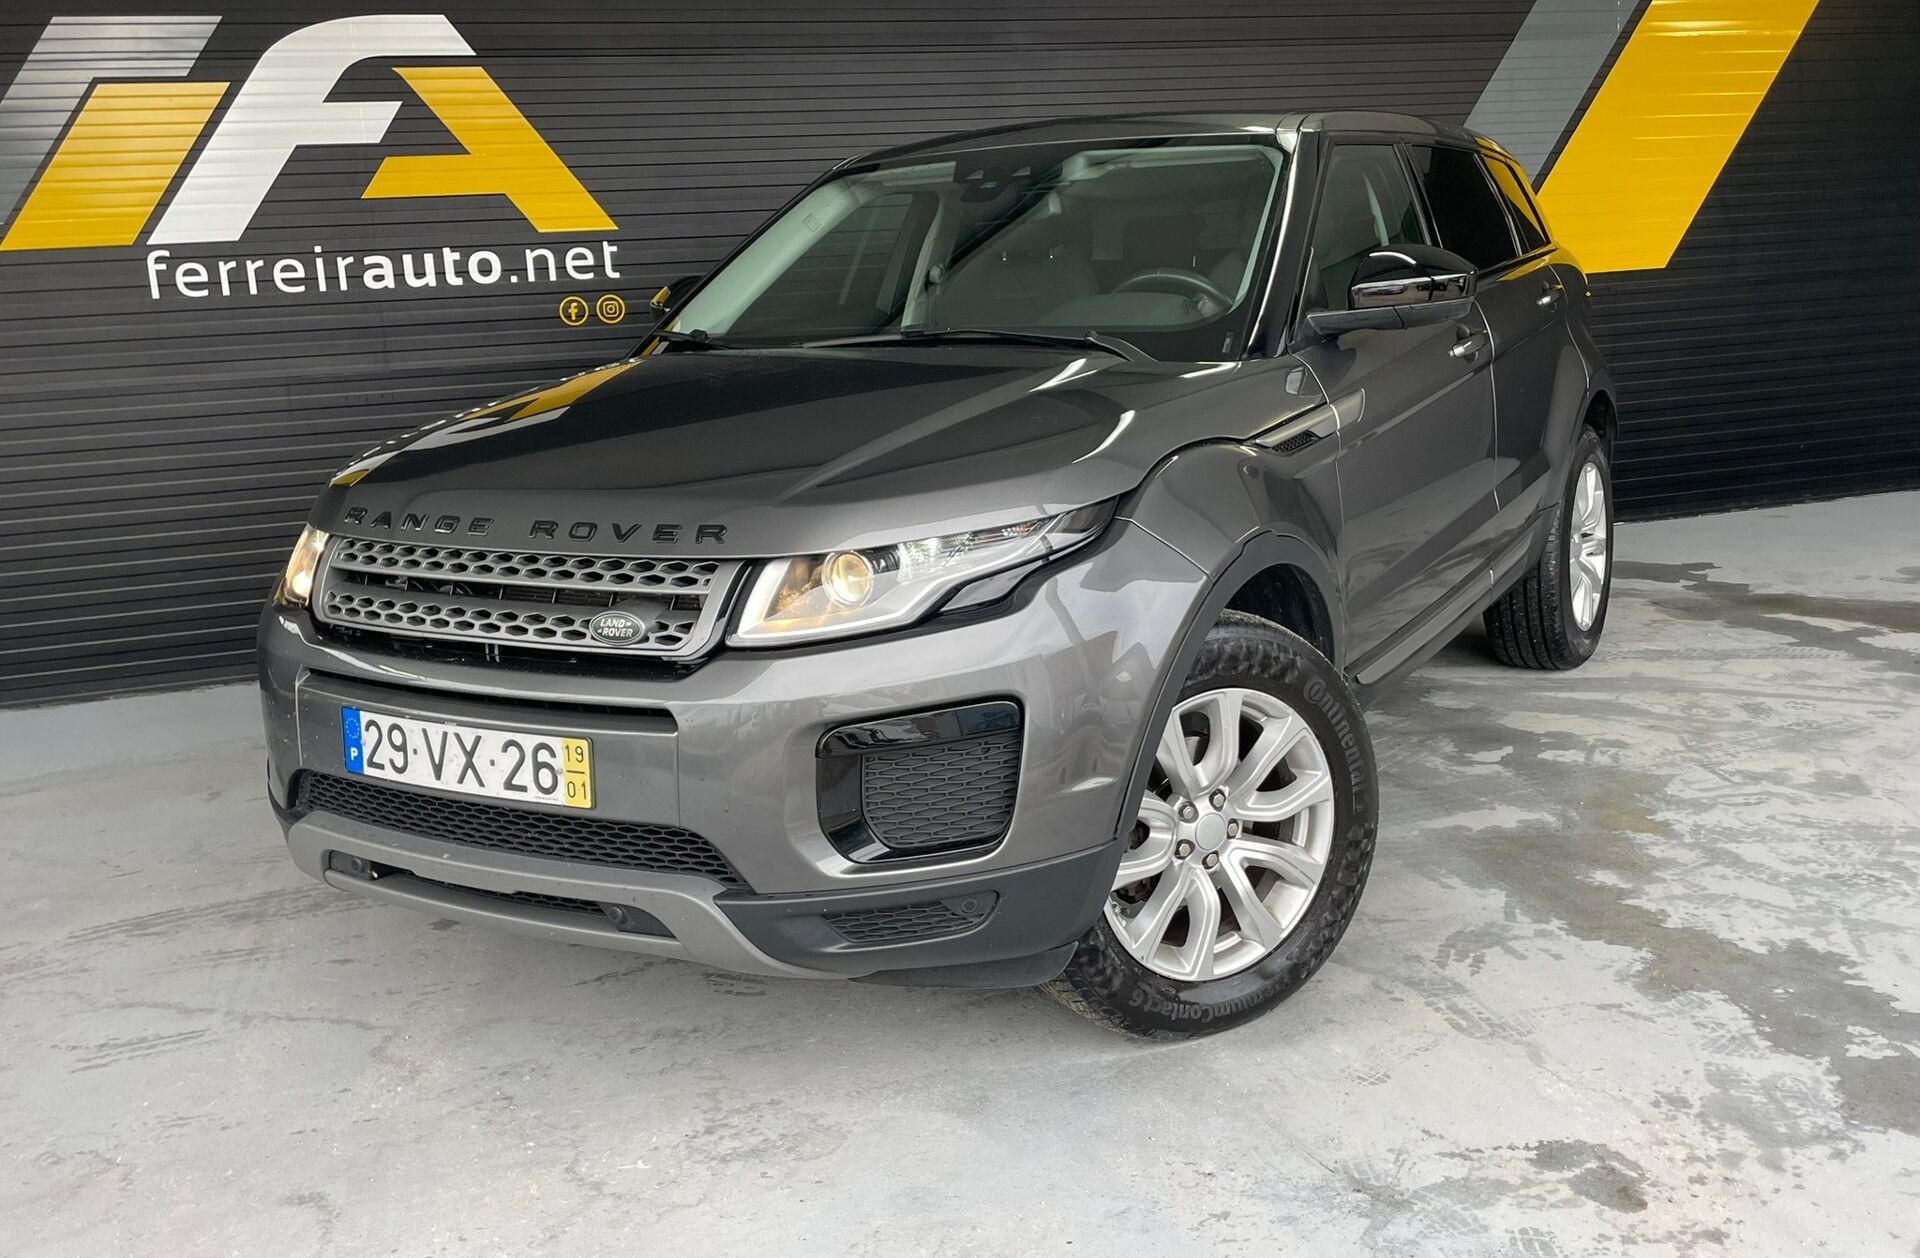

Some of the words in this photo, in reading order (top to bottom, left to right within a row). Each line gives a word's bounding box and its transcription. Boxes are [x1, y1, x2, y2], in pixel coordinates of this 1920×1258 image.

[146, 240, 621, 299] ferreirauto.net
[343, 506, 495, 537] RANGE
[529, 520, 728, 545] ROVER
[600, 618, 626, 628] LAND
[602, 627, 634, 637] ROVER
[1303, 676, 1365, 791] Continental
[351, 747, 358, 761] P
[565, 744, 585, 763] 19
[567, 781, 587, 800] 01
